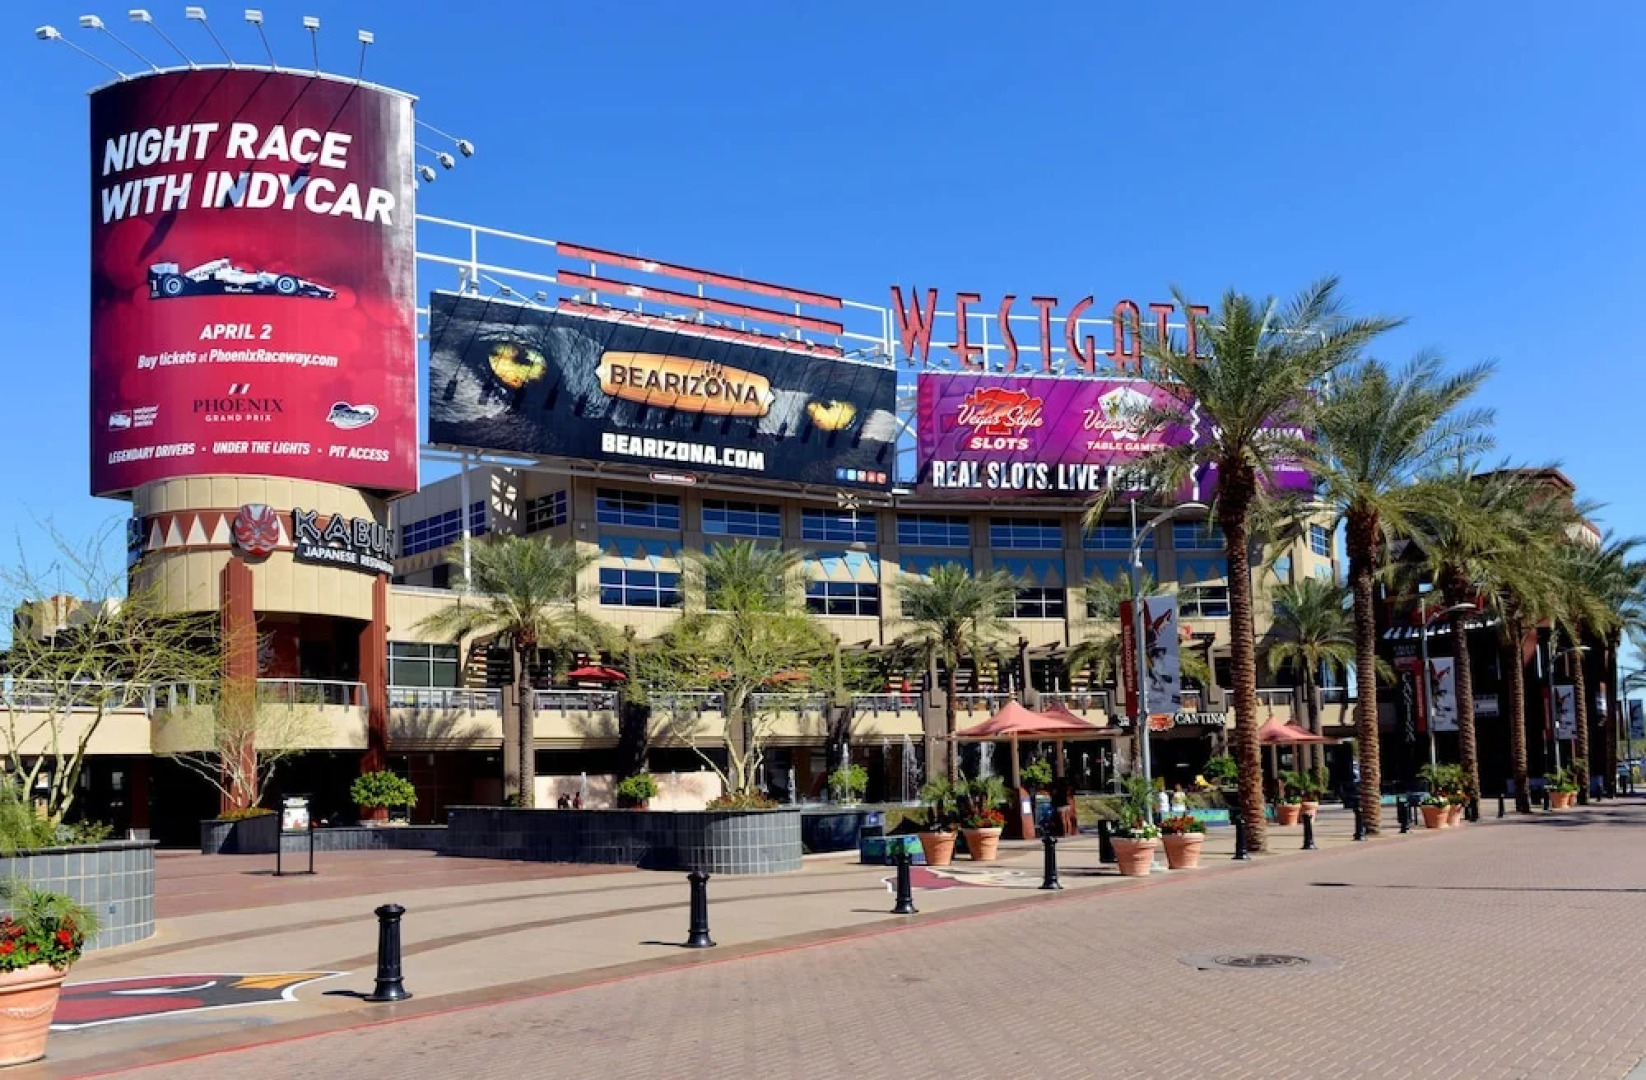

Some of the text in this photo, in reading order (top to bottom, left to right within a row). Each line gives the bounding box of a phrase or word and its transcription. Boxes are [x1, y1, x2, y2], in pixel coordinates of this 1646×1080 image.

[102, 122, 352, 176] NIGHT RACE
[101, 172, 396, 225] WITH INDYCAR
[200, 324, 273, 339] APRIL 2
[890, 285, 1209, 375] WESTGATE
[137, 355, 158, 369] Buy
[160, 350, 197, 366] tickets
[208, 349, 339, 367] PhoenixRaceway.com
[610, 363, 760, 406] BEARIZONA
[193, 399, 283, 413] PHOENIX
[957, 404, 1044, 434] Vegas Style
[1083, 409, 1124, 439] Vegas
[108, 441, 390, 464] LEGENDARY DRIVERS UNDER THE LIGHTS PIT ACCESS
[601, 432, 765, 470] BEARIZONA.COM
[970, 438, 1030, 450] SLOTS
[1087, 441, 1123, 451] TABLE
[932, 460, 982, 488] REAL
[986, 460, 1053, 490] SLOTS.
[1058, 463, 1100, 490] LIVE
[303, 546, 358, 564] JAPANESE
